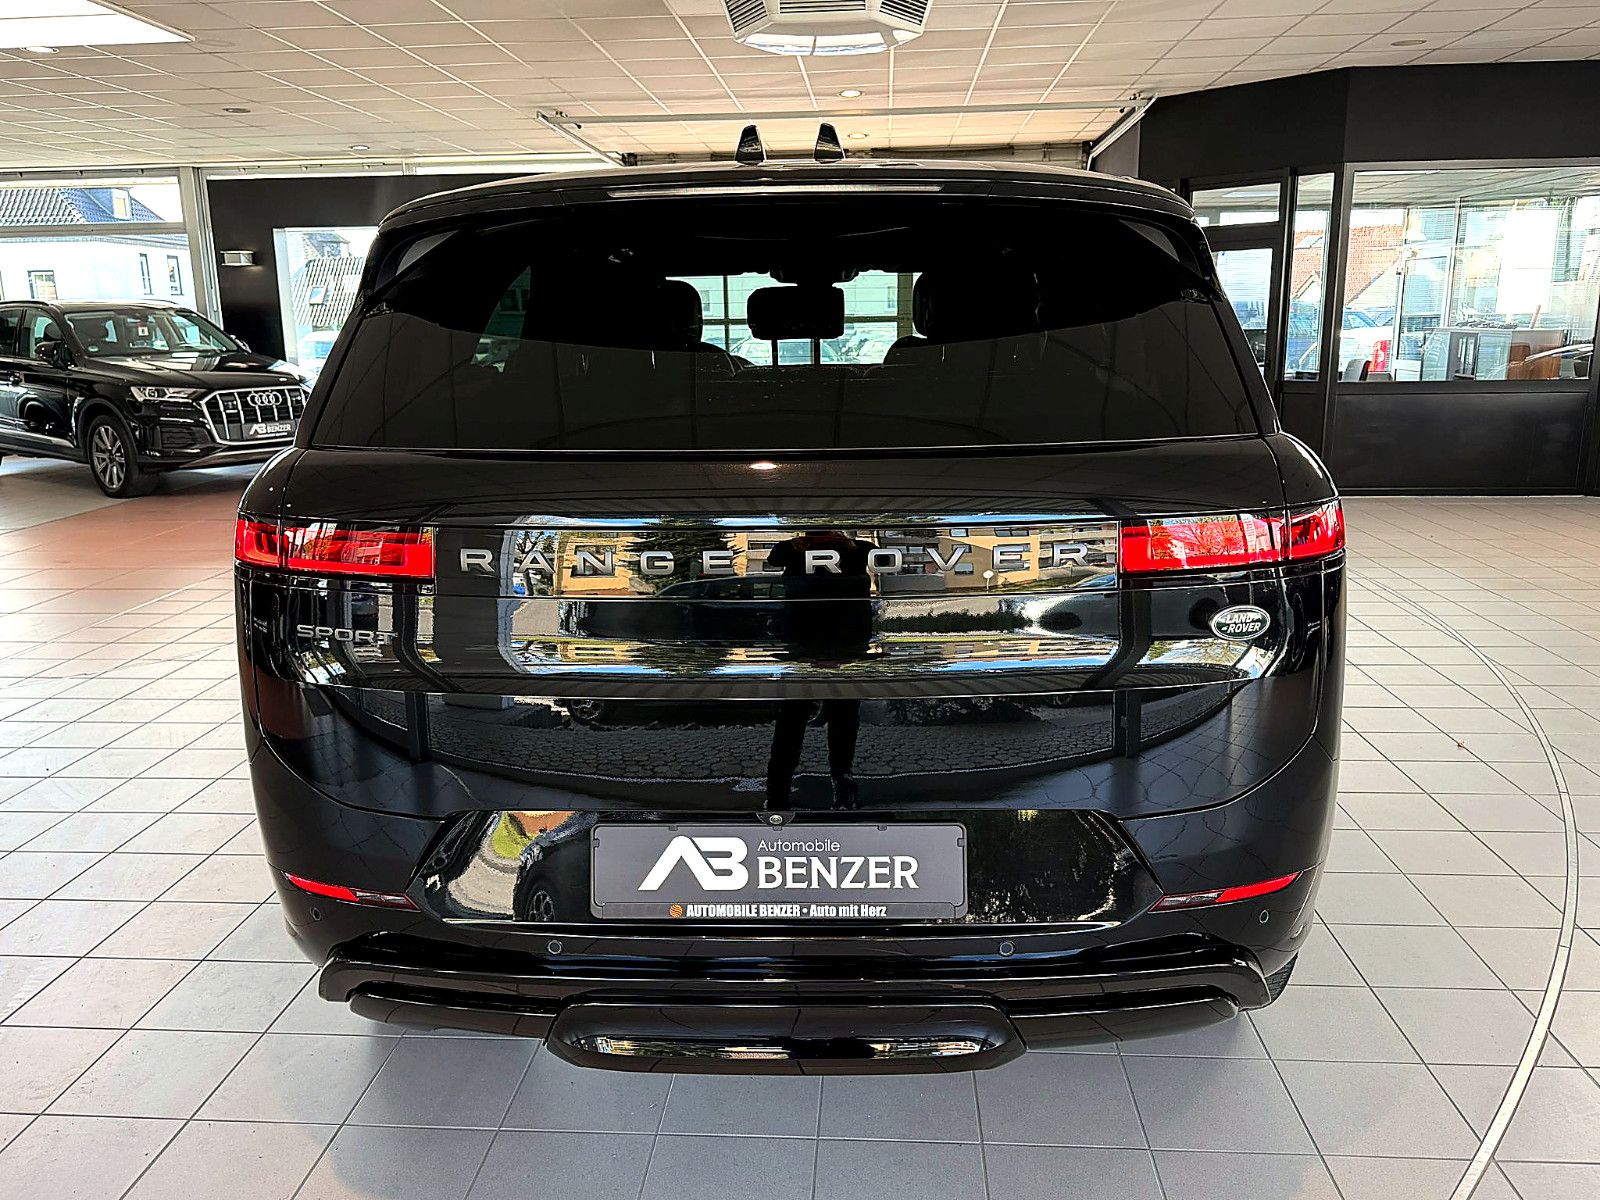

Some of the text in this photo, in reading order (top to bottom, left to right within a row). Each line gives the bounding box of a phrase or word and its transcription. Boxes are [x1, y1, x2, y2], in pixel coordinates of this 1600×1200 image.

[460, 542, 1089, 577] RANGE ROVER
[1225, 612, 1255, 624] LAND
[296, 624, 398, 645] SPORT
[1227, 622, 1261, 634] ROVER
[757, 839, 841, 852] Automobile
[638, 835, 750, 891] AB
[757, 856, 920, 889] BENZER
[686, 904, 887, 917] AUTOMOBILE BENZER Auto mit Herz
